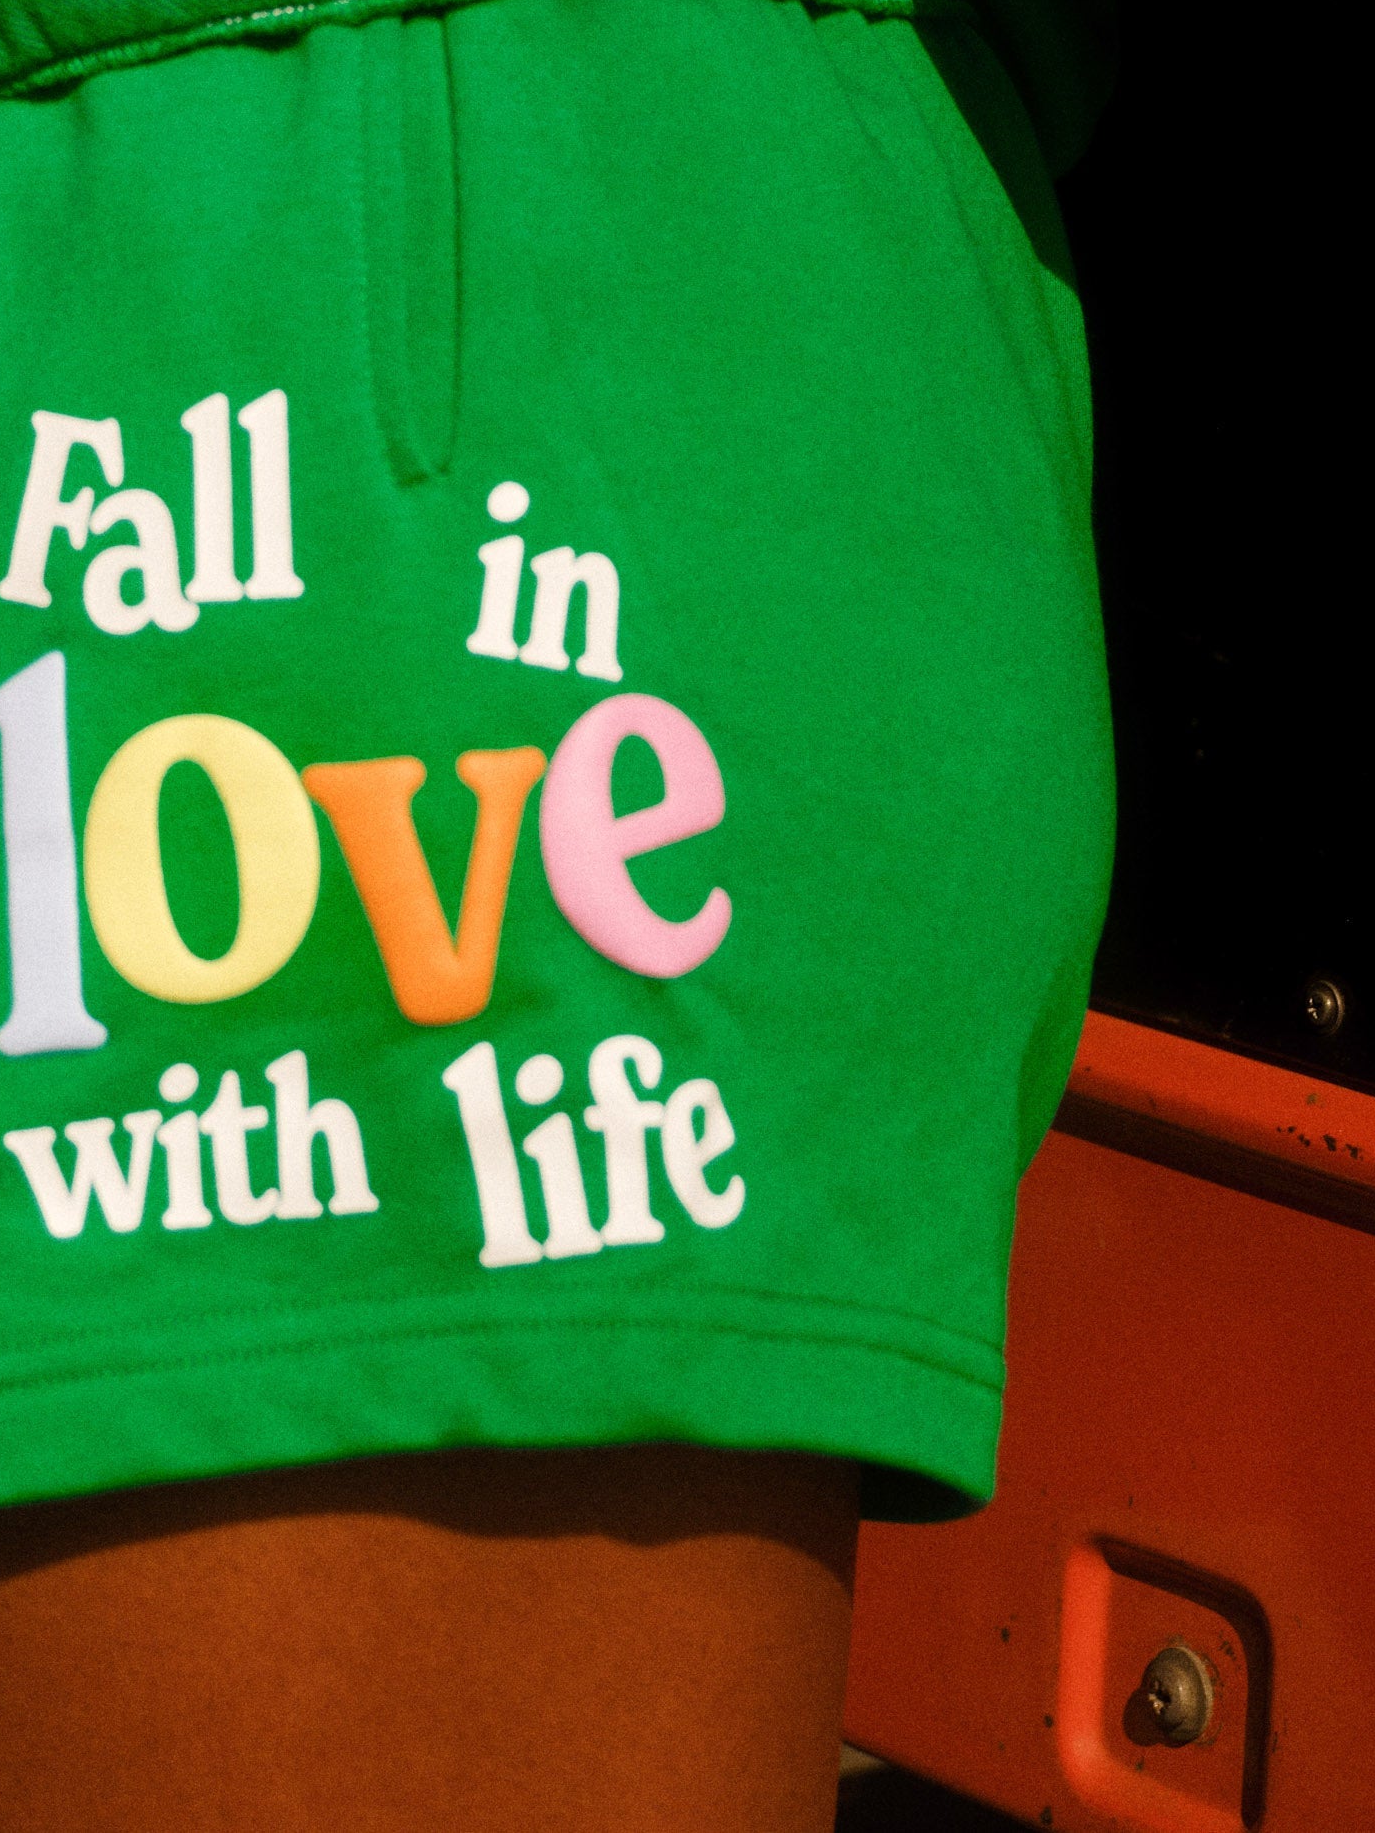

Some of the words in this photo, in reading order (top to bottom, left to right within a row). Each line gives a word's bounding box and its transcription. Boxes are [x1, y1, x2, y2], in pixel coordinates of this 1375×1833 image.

[467, 482, 623, 681] in
[4, 1050, 379, 1238] with
[443, 1035, 745, 1267] life
